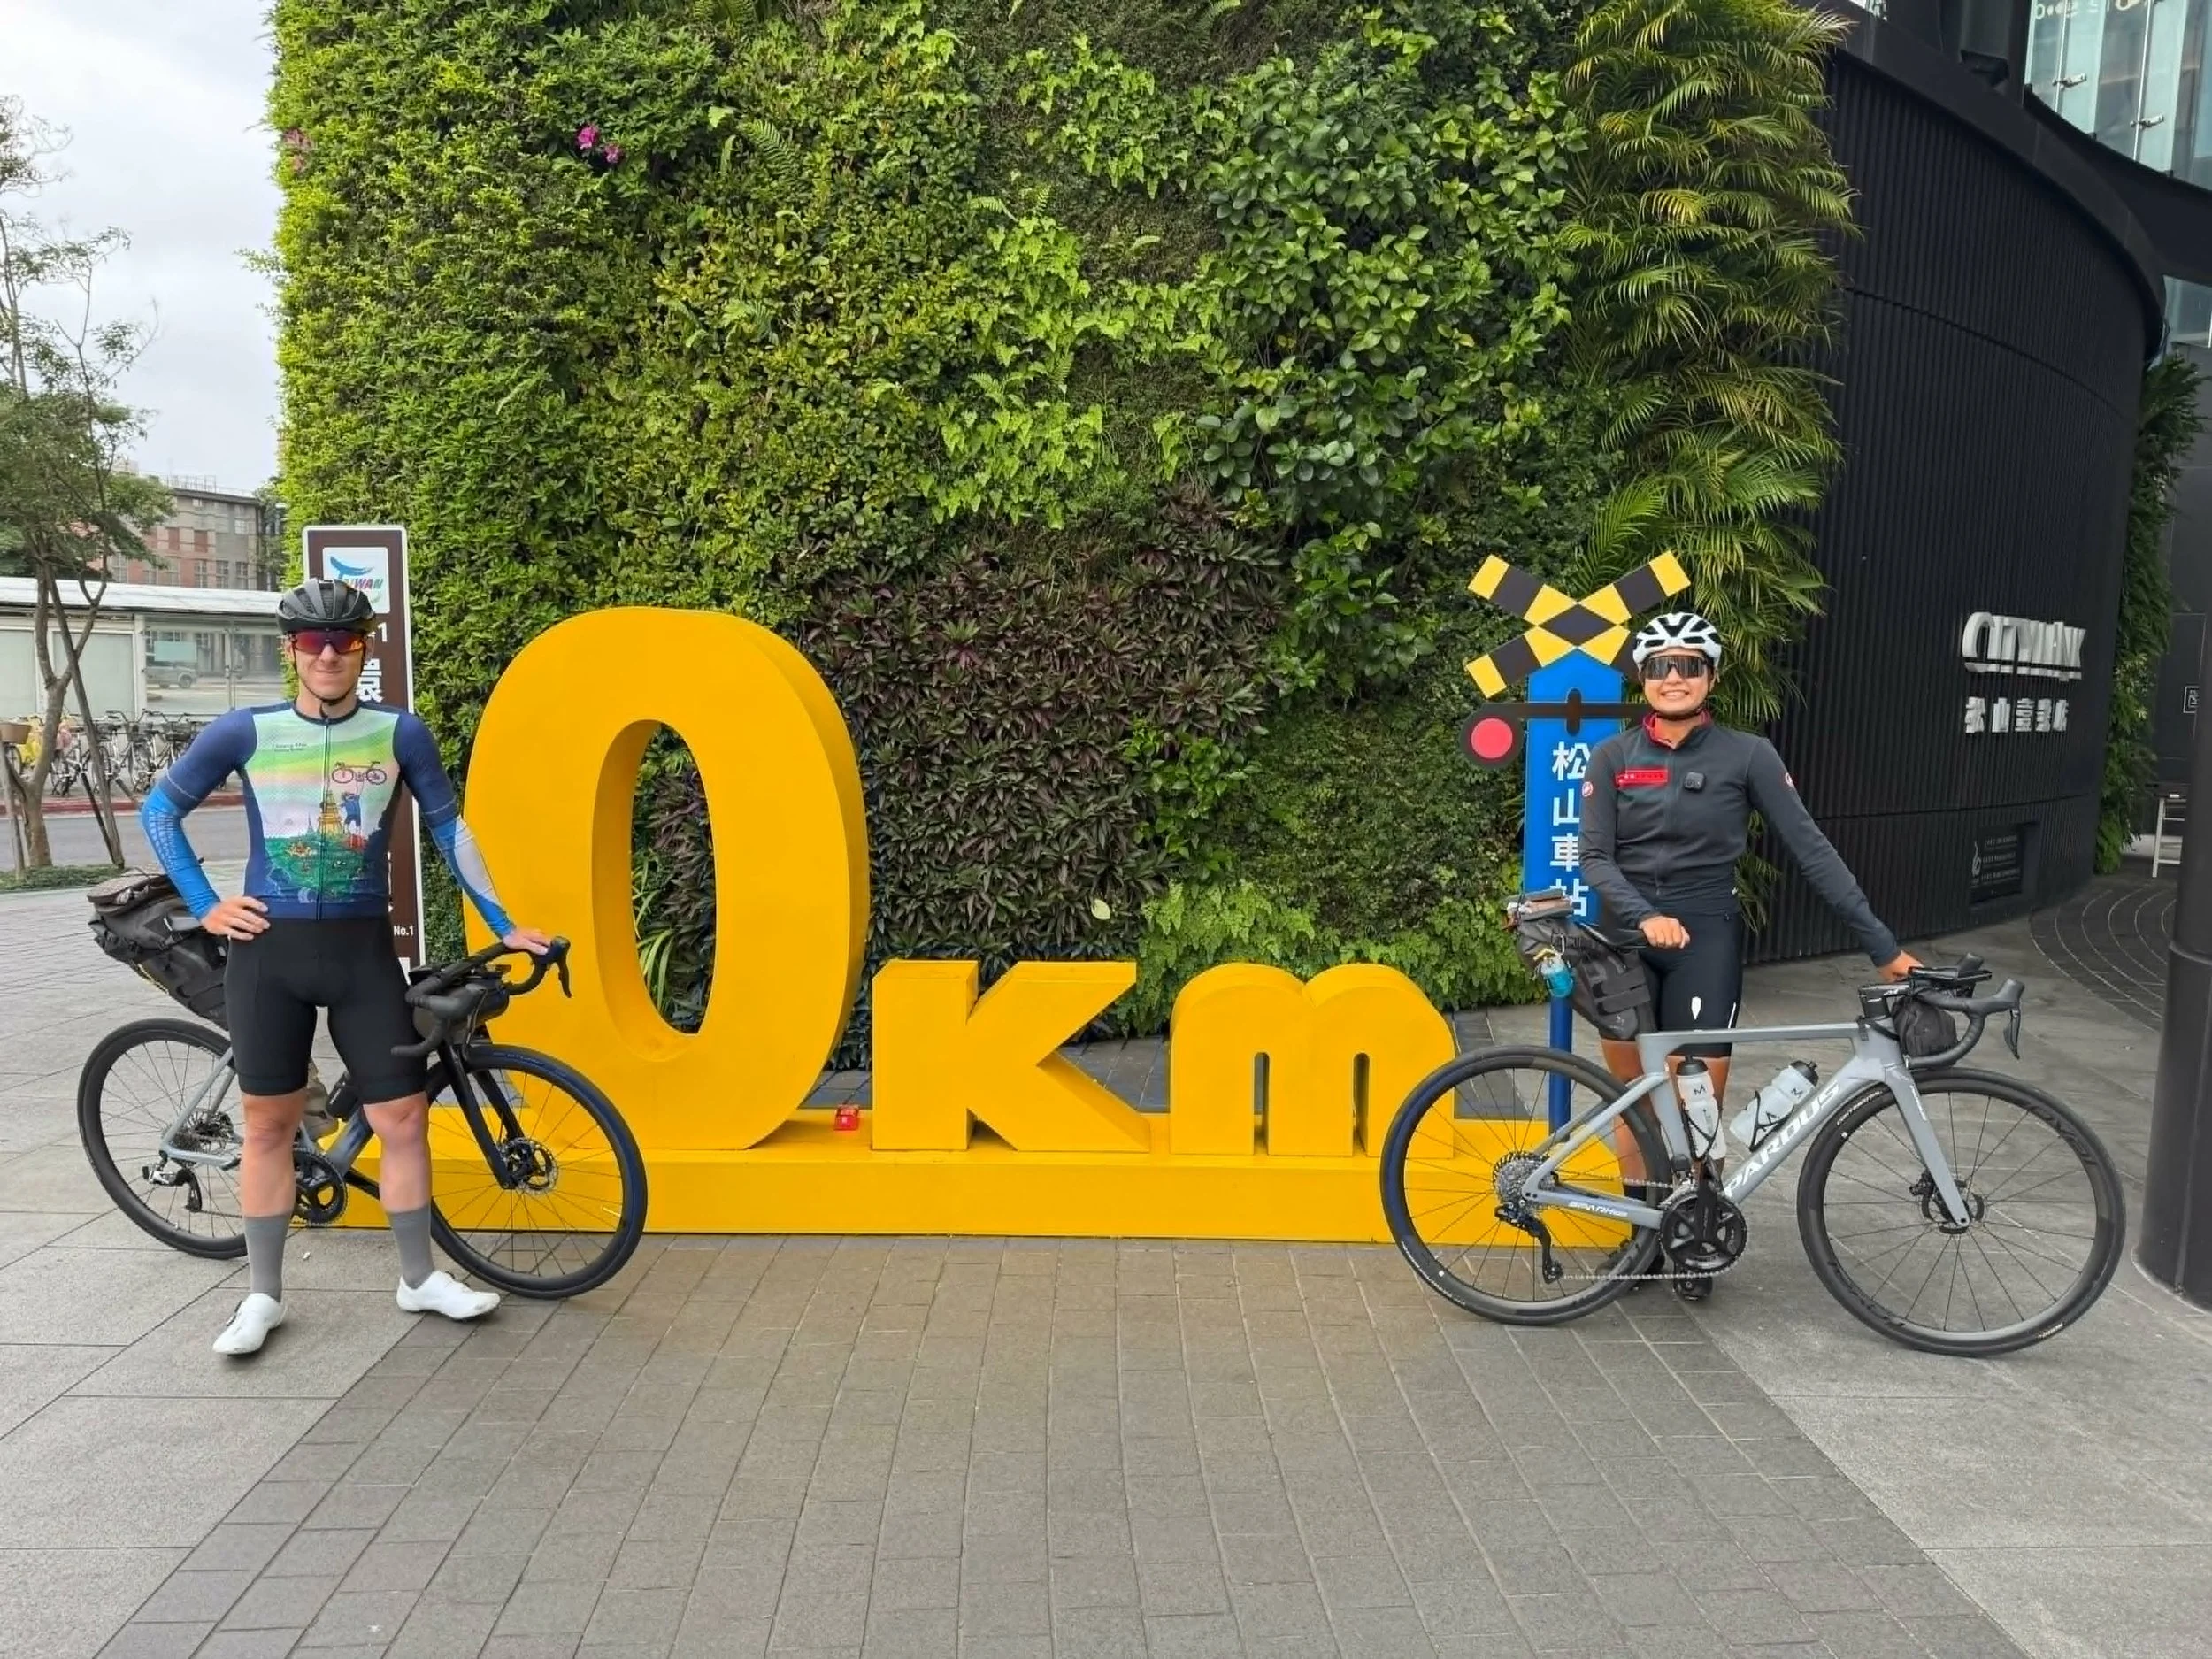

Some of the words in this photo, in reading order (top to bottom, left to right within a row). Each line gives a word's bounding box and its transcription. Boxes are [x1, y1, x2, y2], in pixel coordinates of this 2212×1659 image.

[1549, 741, 1591, 918] 松山車站
[393, 925, 414, 936] No.1
[1724, 1079, 1839, 1197] PARDUS
